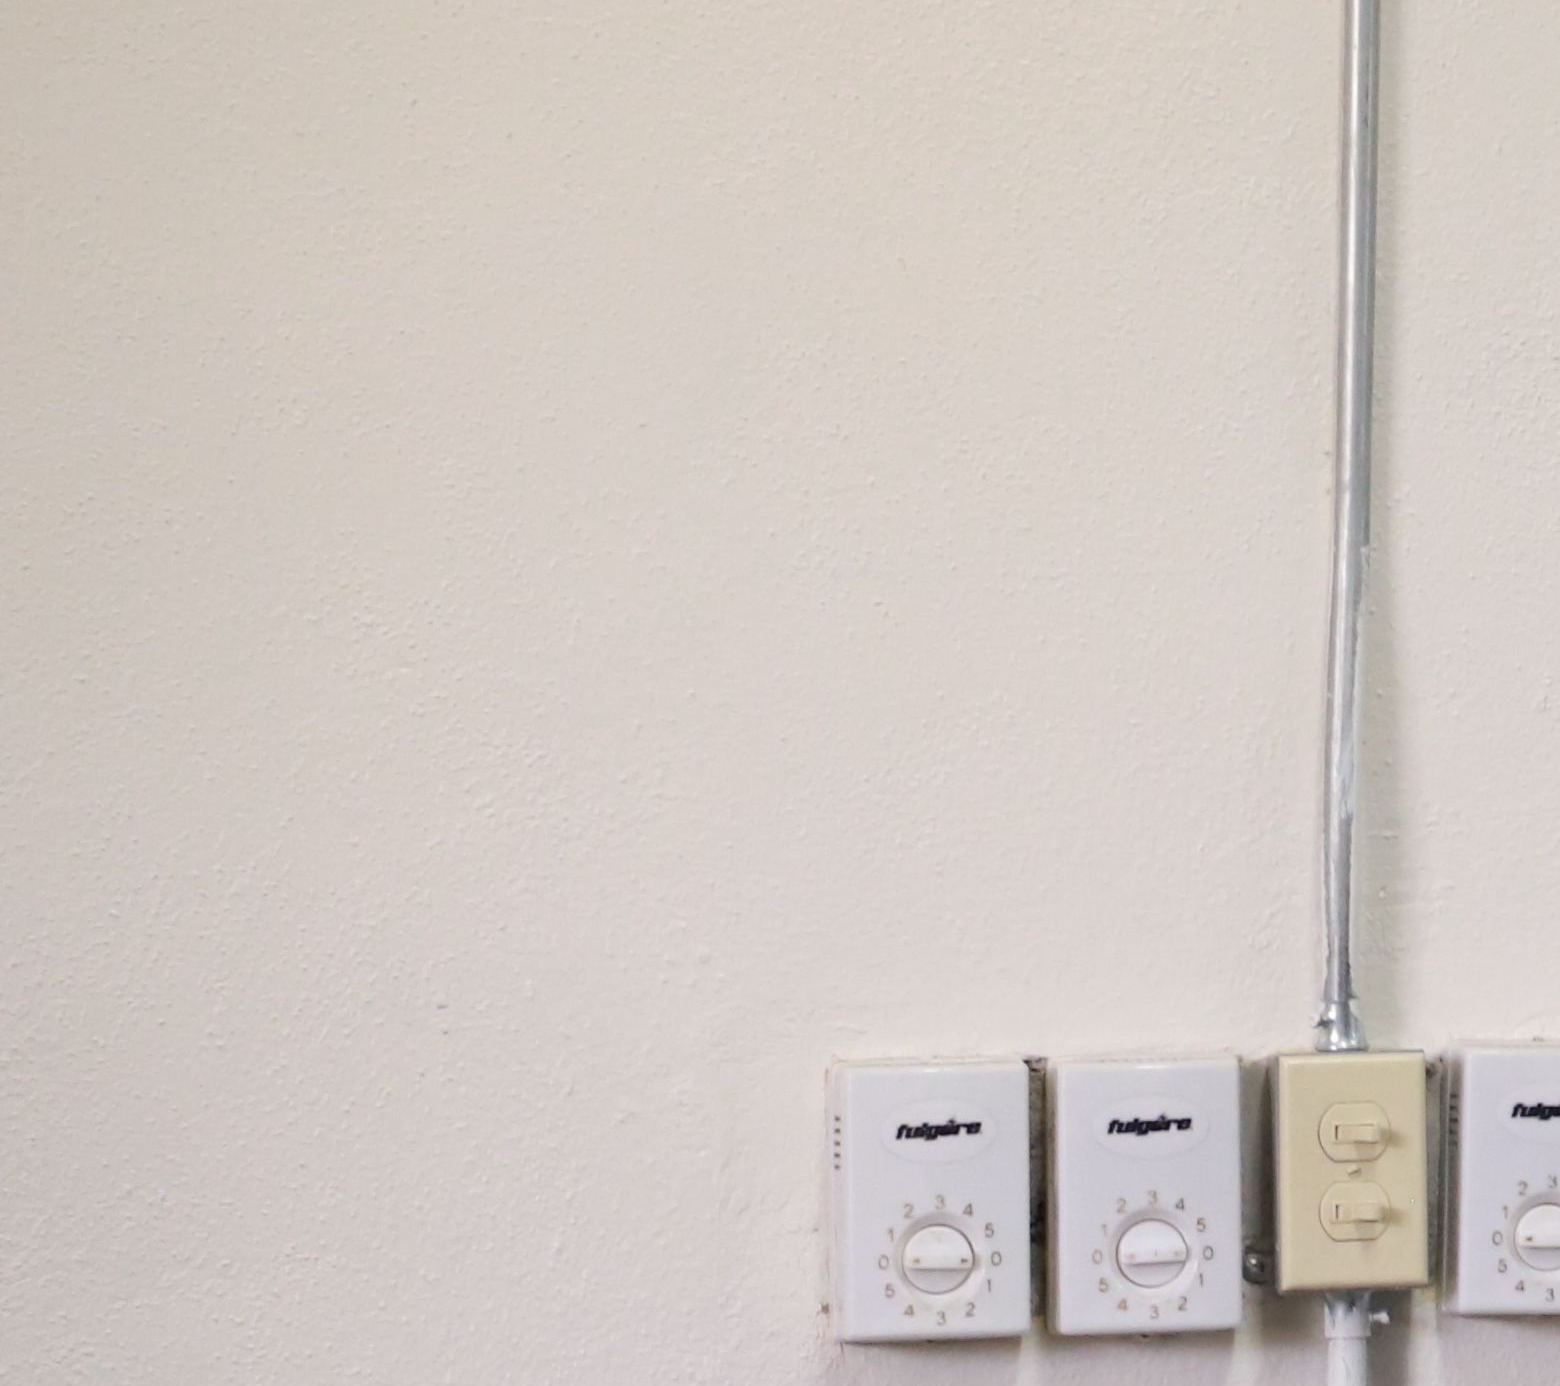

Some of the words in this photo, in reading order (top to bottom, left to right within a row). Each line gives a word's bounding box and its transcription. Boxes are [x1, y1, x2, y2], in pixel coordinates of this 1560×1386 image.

[1492, 1231, 1503, 1247] 0
[1518, 1180, 1528, 1195] 2
[1548, 1174, 1558, 1189] 3
[879, 1256, 890, 1270] 0
[903, 1203, 915, 1218] 2
[935, 1195, 946, 1210] 3
[963, 1203, 974, 1217] 4
[984, 1223, 995, 1238] 5
[1092, 1250, 1103, 1264] 0
[1117, 1199, 1127, 1213] 2
[1148, 1190, 1158, 1205] 3
[1175, 1197, 1186, 1211] 4
[1197, 1218, 1207, 1232] 5
[990, 1251, 1002, 1266] 0
[1202, 1246, 1214, 1261] 0
[1498, 1259, 1508, 1273] 5
[885, 1284, 896, 1299] 5
[1099, 1278, 1109, 1292] 5
[1515, 1277, 1525, 1292] 4
[1545, 1288, 1555, 1302] 3
[965, 1303, 976, 1317] 2
[1116, 1298, 1128, 1312] 4
[1177, 1297, 1188, 1311] 2
[903, 1305, 915, 1319] 4
[936, 1311, 947, 1326] 3
[1149, 1305, 1159, 1319] 3
